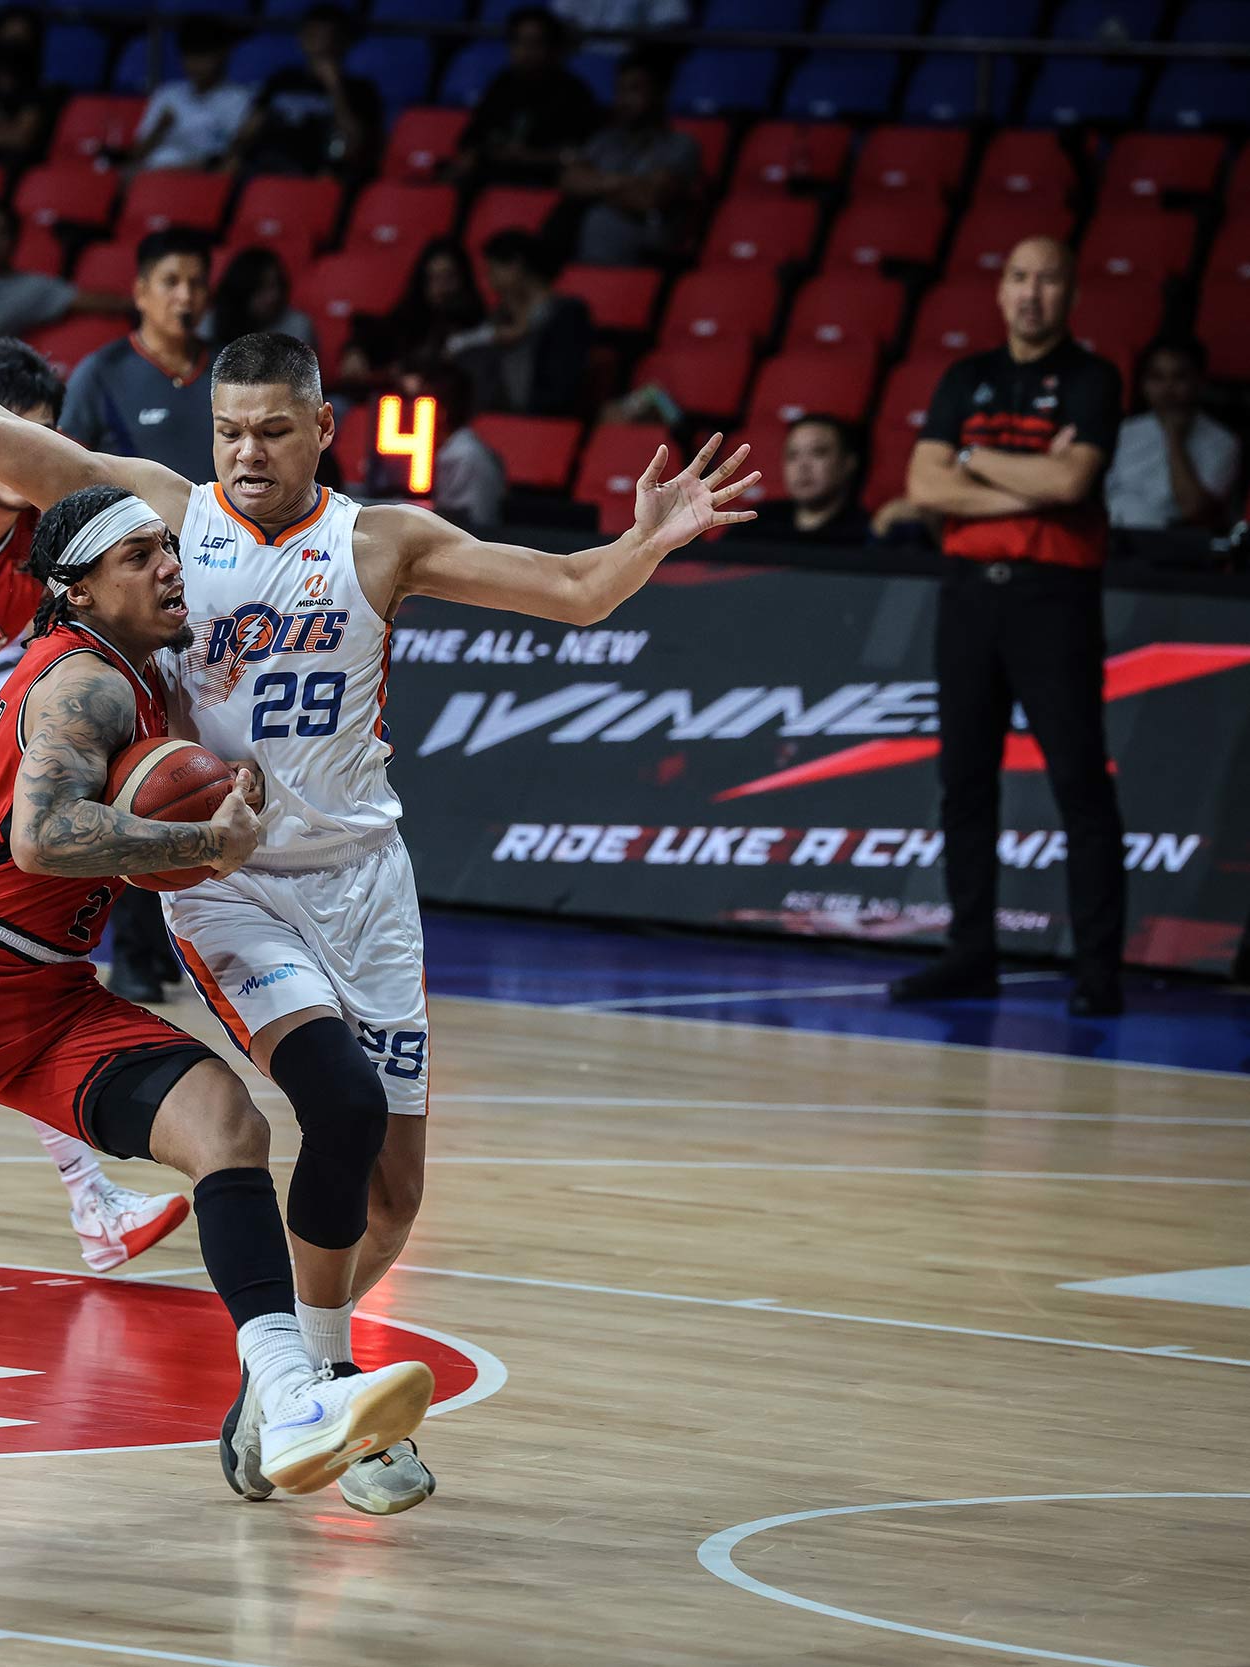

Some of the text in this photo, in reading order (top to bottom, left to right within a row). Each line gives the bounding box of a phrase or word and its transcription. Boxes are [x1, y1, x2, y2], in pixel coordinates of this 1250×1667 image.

[376, 395, 436, 493] 4
[301, 549, 331, 562] PBA
[296, 599, 333, 608] MERALCO
[205, 600, 351, 667] BOLTS
[391, 628, 468, 663] THE
[554, 629, 650, 665] NEW
[251, 671, 347, 742] 29
[416, 680, 1029, 758] WINNE
[492, 823, 1202, 873] RIDE LIKE A CHMPON
[68, 885, 113, 943] 2
